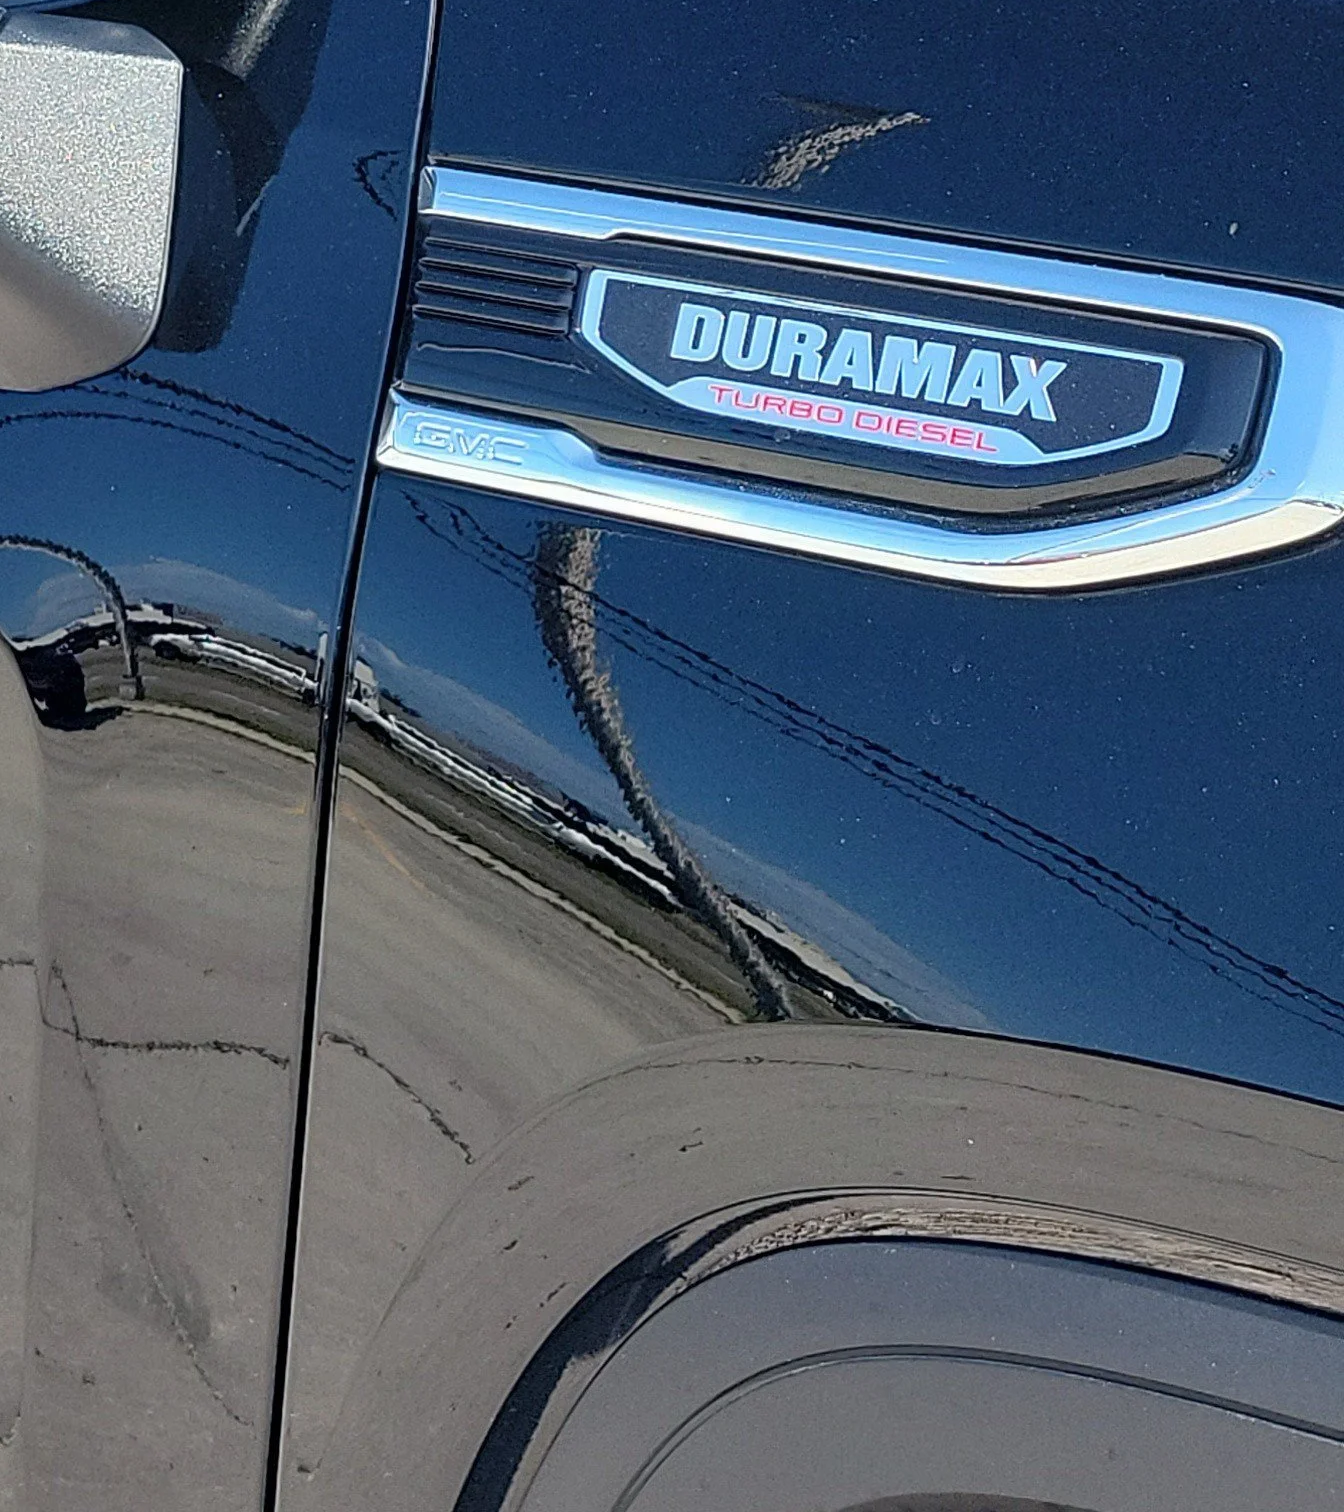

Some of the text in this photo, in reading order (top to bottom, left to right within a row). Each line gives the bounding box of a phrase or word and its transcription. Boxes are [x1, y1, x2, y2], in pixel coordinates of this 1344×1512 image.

[669, 302, 1068, 422] DURAMAX
[413, 421, 530, 466] GMC
[708, 385, 998, 453] TURBO DIESEL
